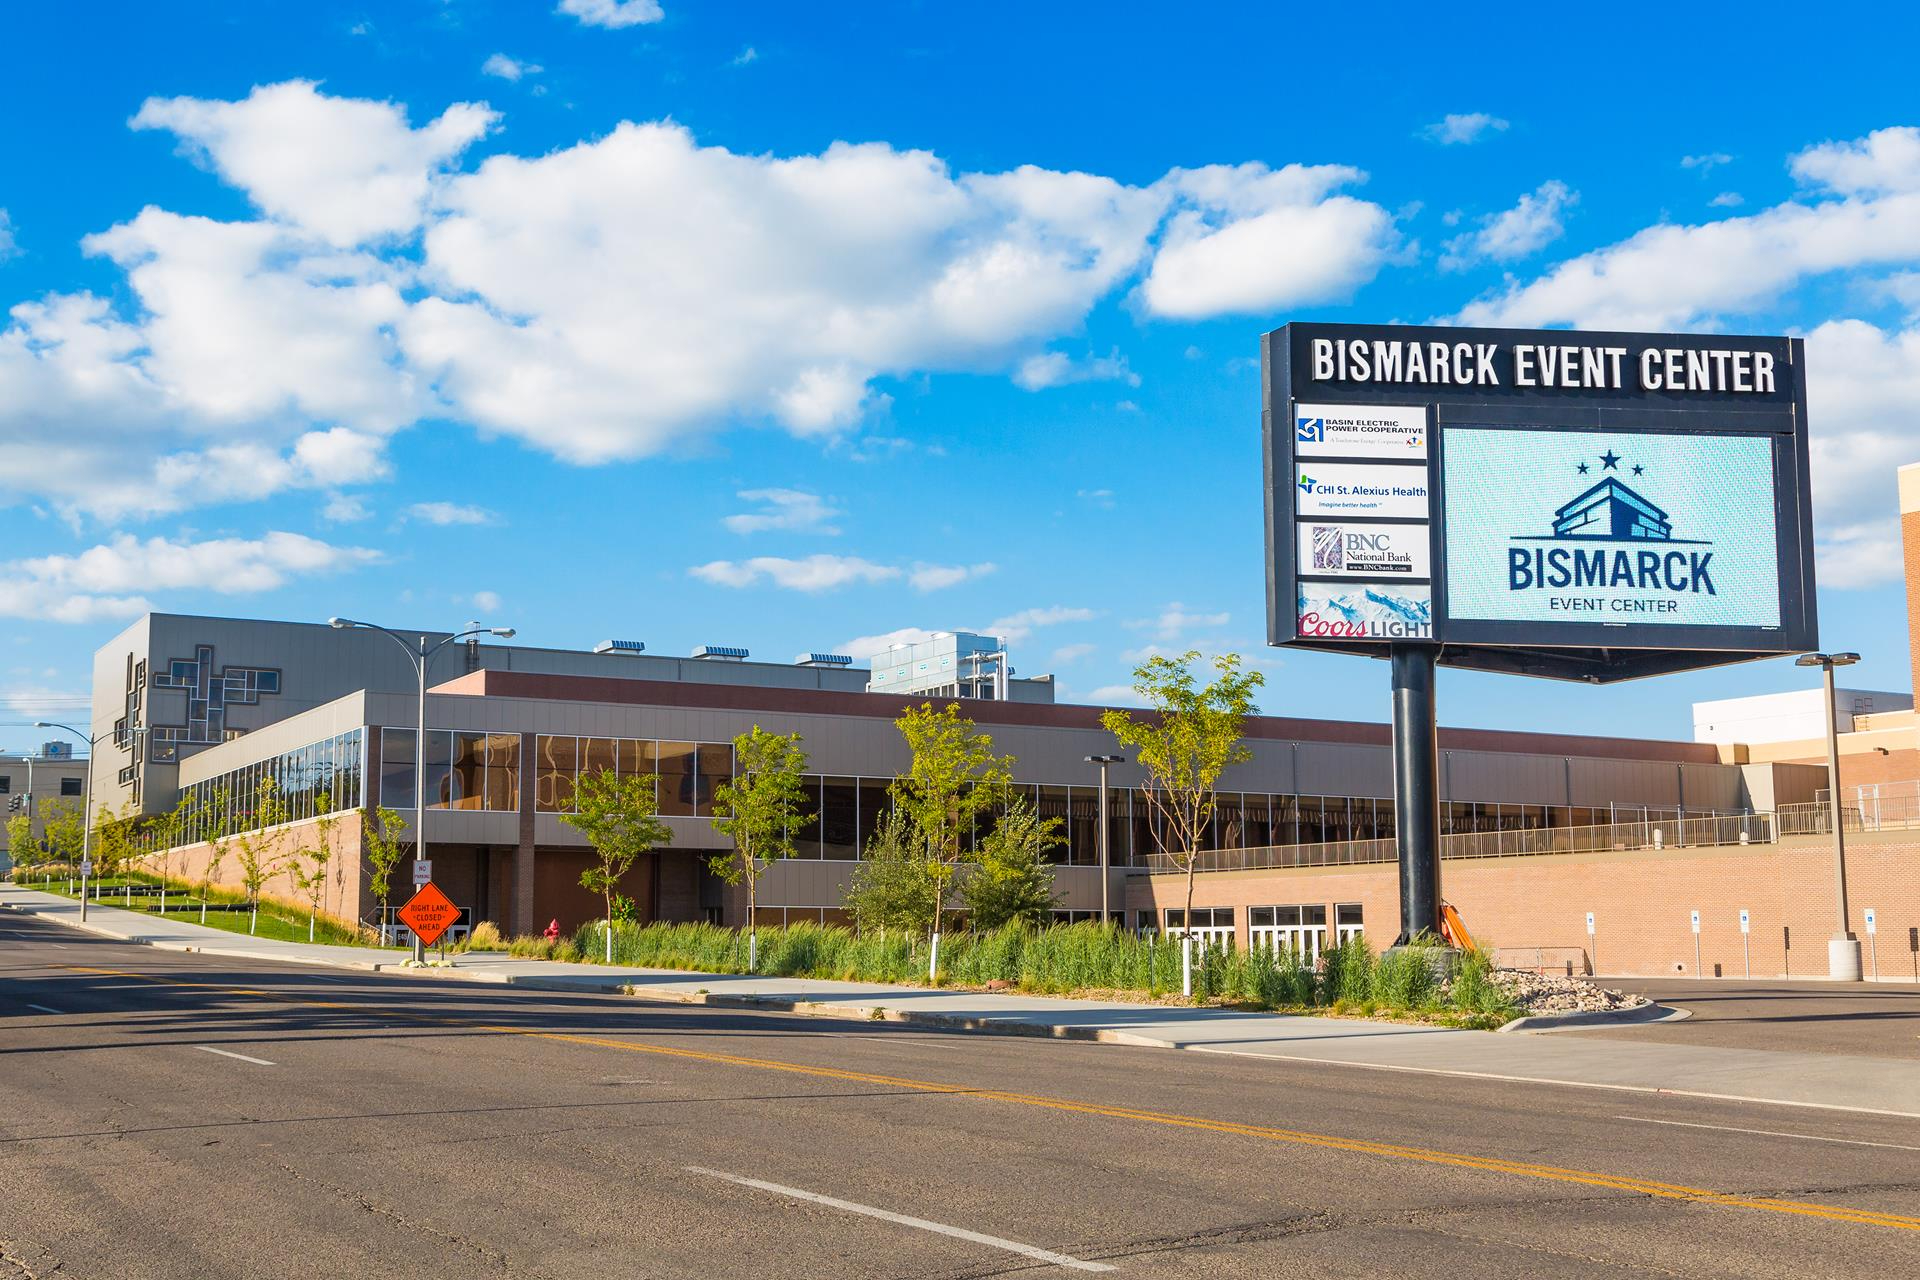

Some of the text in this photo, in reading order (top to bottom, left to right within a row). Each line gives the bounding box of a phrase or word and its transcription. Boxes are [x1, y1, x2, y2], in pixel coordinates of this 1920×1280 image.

[1311, 338, 1776, 393] BISMARCK EVENT CENTER
[1316, 485, 1427, 497] CHI St. Alexius Health
[1345, 533, 1390, 551] BNC
[1346, 551, 1412, 562] National Bank
[1508, 547, 1717, 596] BISMARCK
[1550, 597, 1678, 612] EVENT CENTER
[1298, 612, 1431, 637] Coors LIGHT
[419, 923, 440, 931] AHEAD
